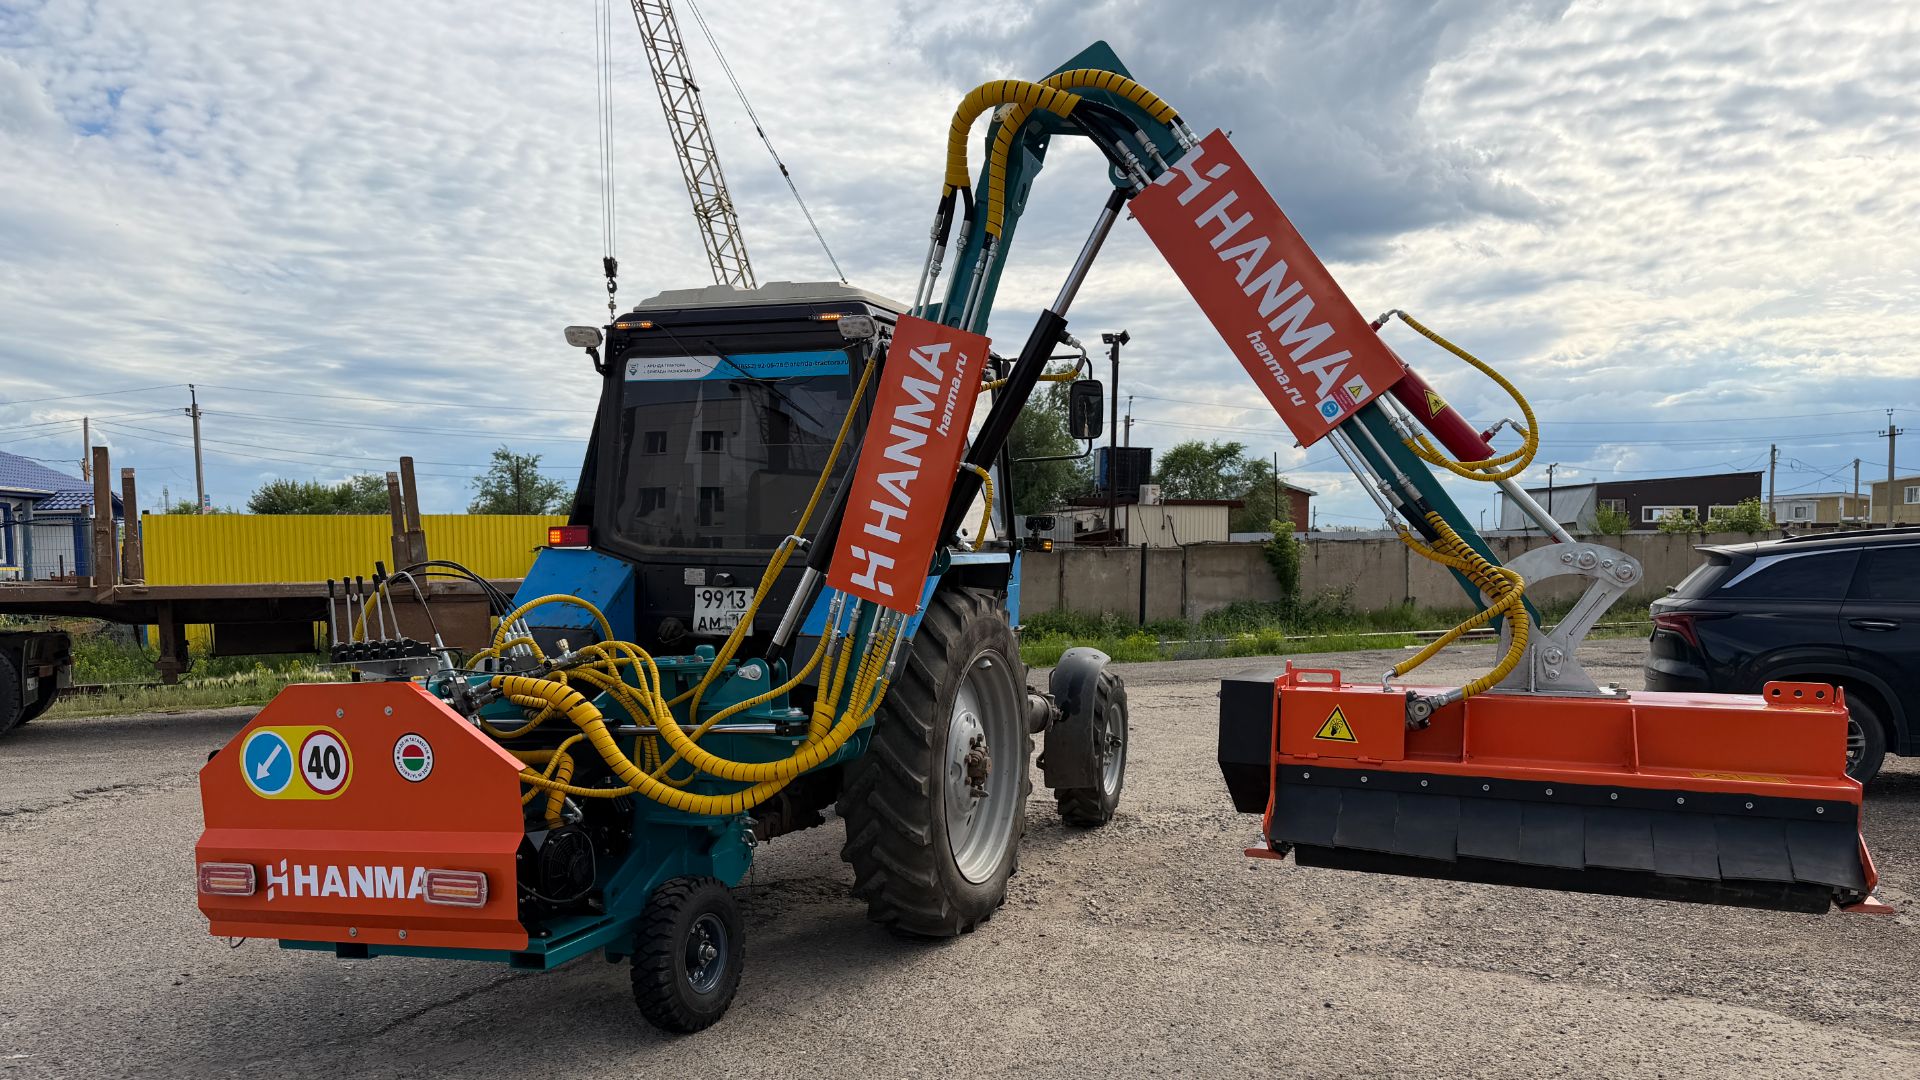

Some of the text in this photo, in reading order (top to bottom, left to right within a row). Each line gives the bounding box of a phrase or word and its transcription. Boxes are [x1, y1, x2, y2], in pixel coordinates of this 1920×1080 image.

[1194, 190, 1353, 400] HANMA
[936, 352, 968, 438] hanma.ru
[1246, 330, 1306, 407] hanma.ru
[863, 342, 952, 544] HANMA
[702, 589, 746, 610] 9913
[307, 745, 341, 781] 40
